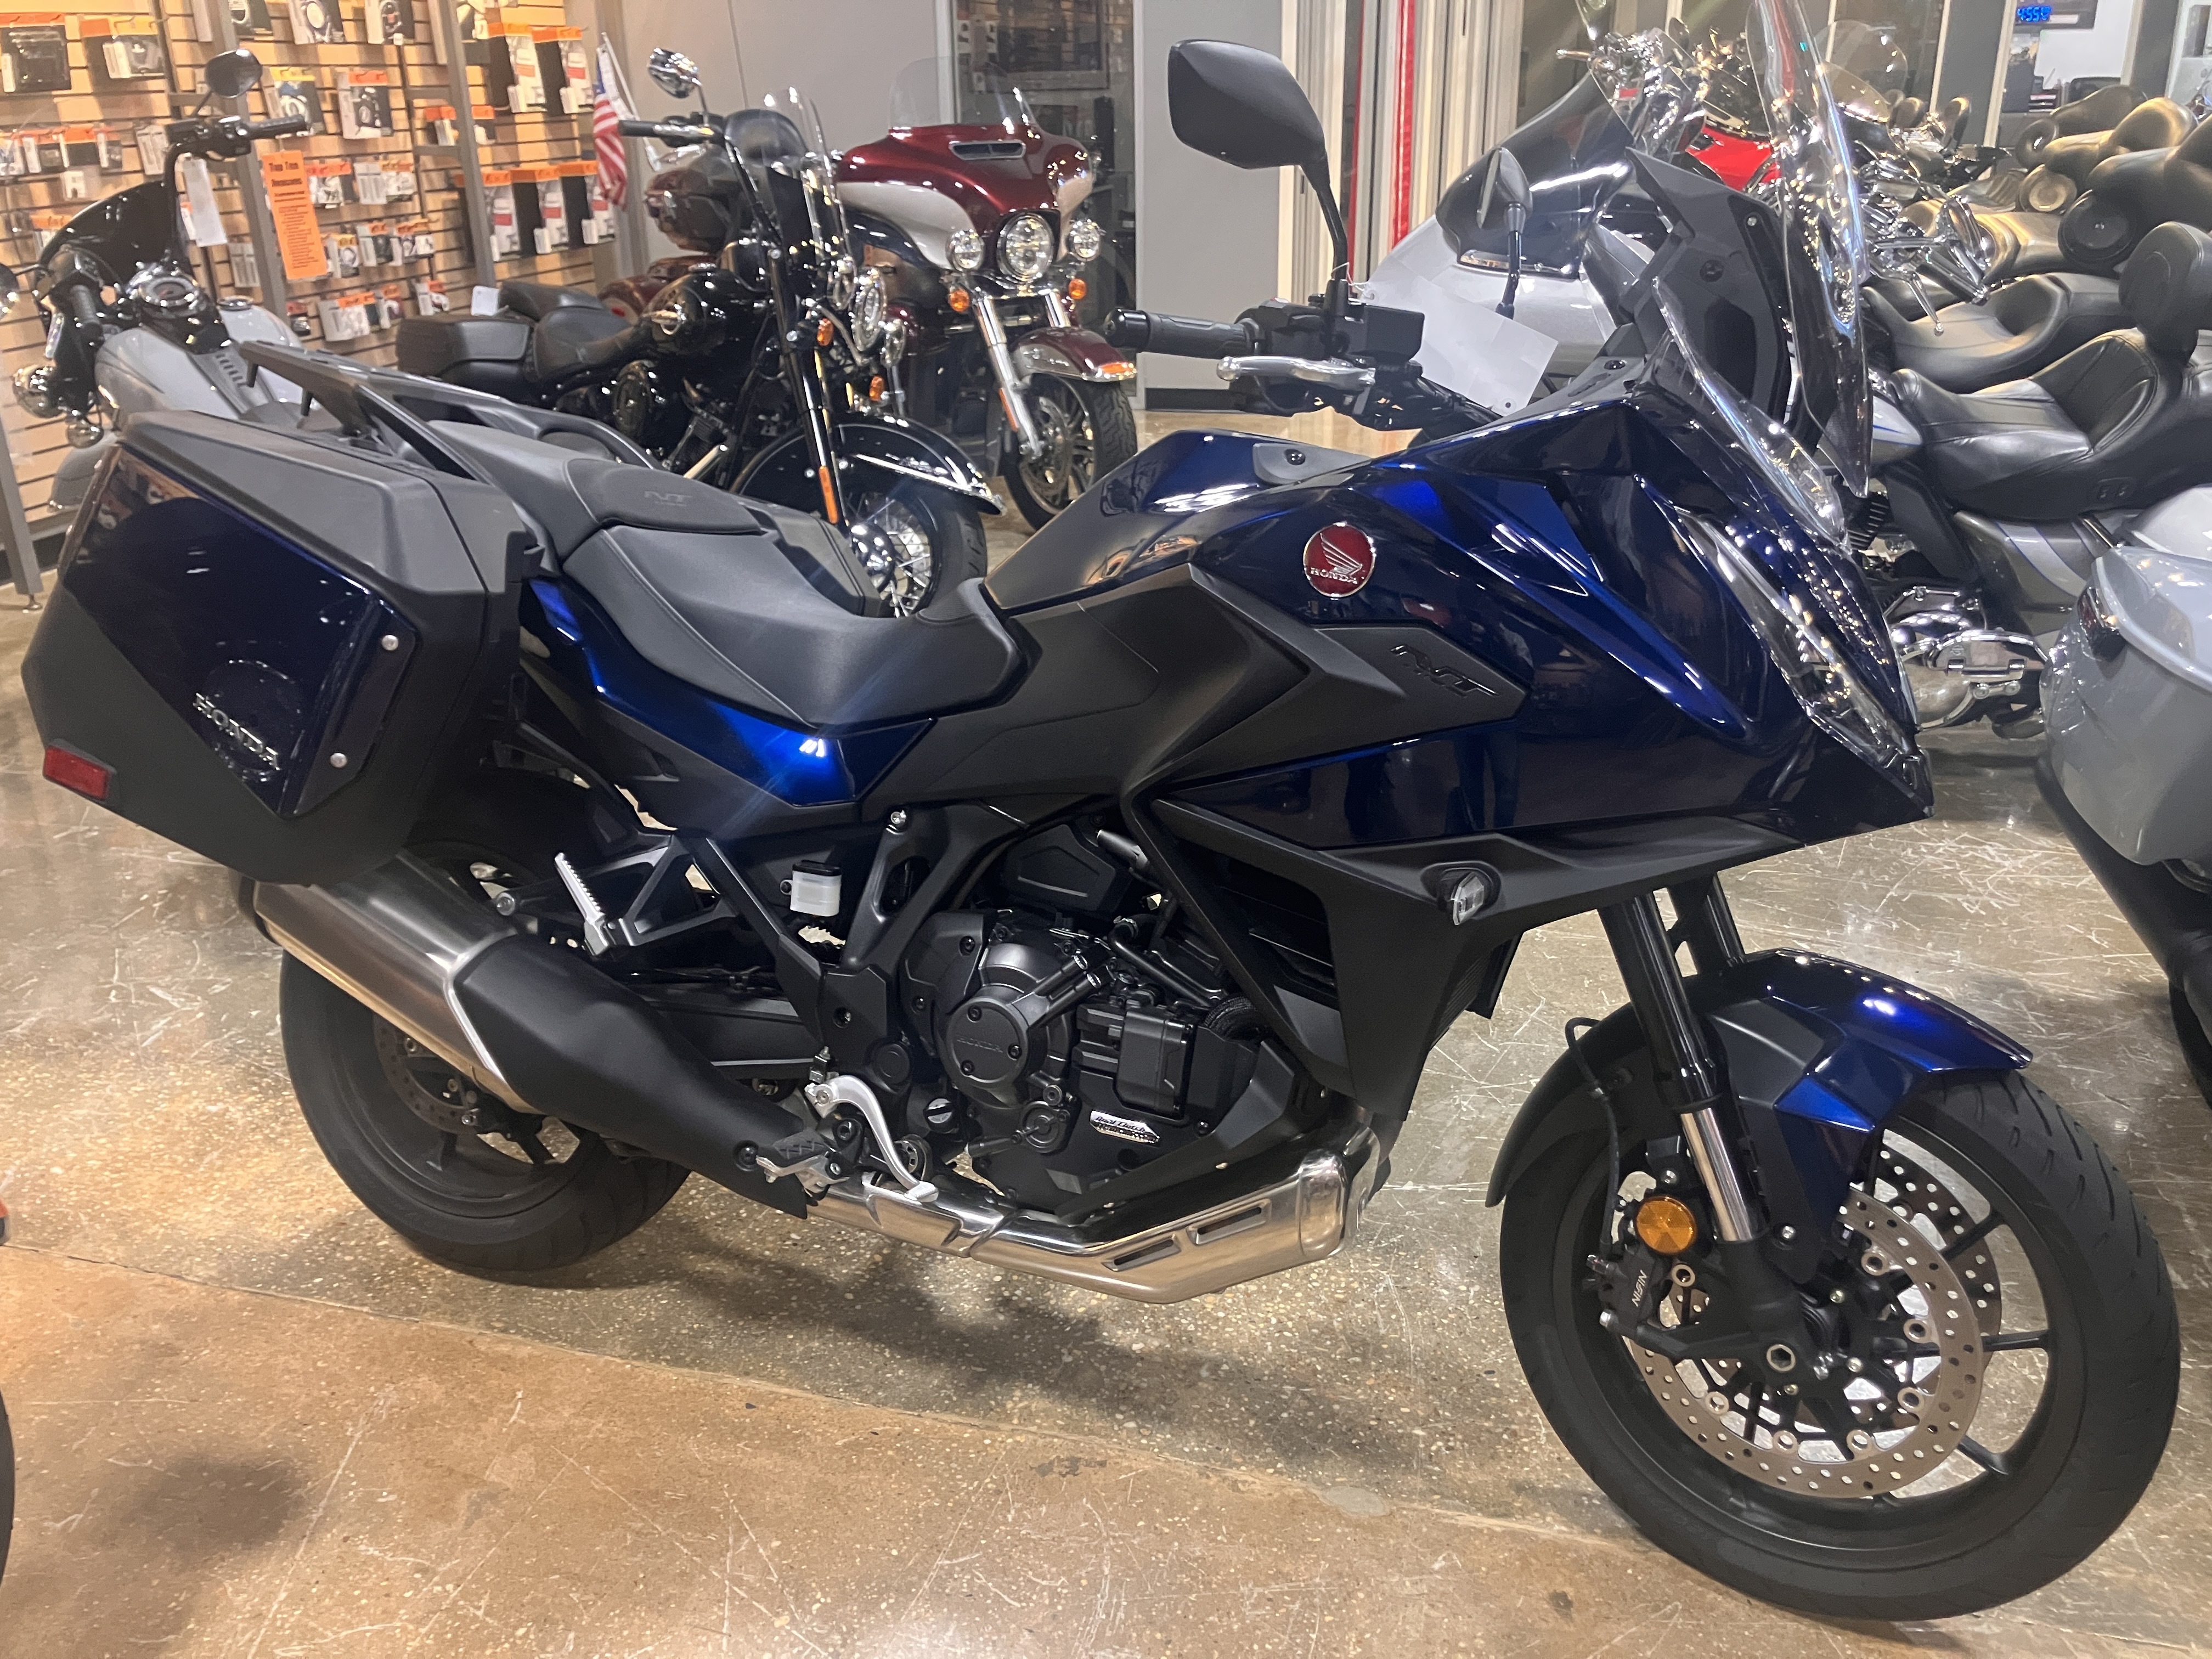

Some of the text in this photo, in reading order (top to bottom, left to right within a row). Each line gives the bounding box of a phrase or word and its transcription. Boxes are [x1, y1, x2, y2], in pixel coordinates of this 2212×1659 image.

[1310, 567, 1358, 584] HONDA
[193, 692, 280, 770] HONDA
[955, 1035, 1003, 1053] HONDA
[1118, 1121, 1146, 1133] Clutch
